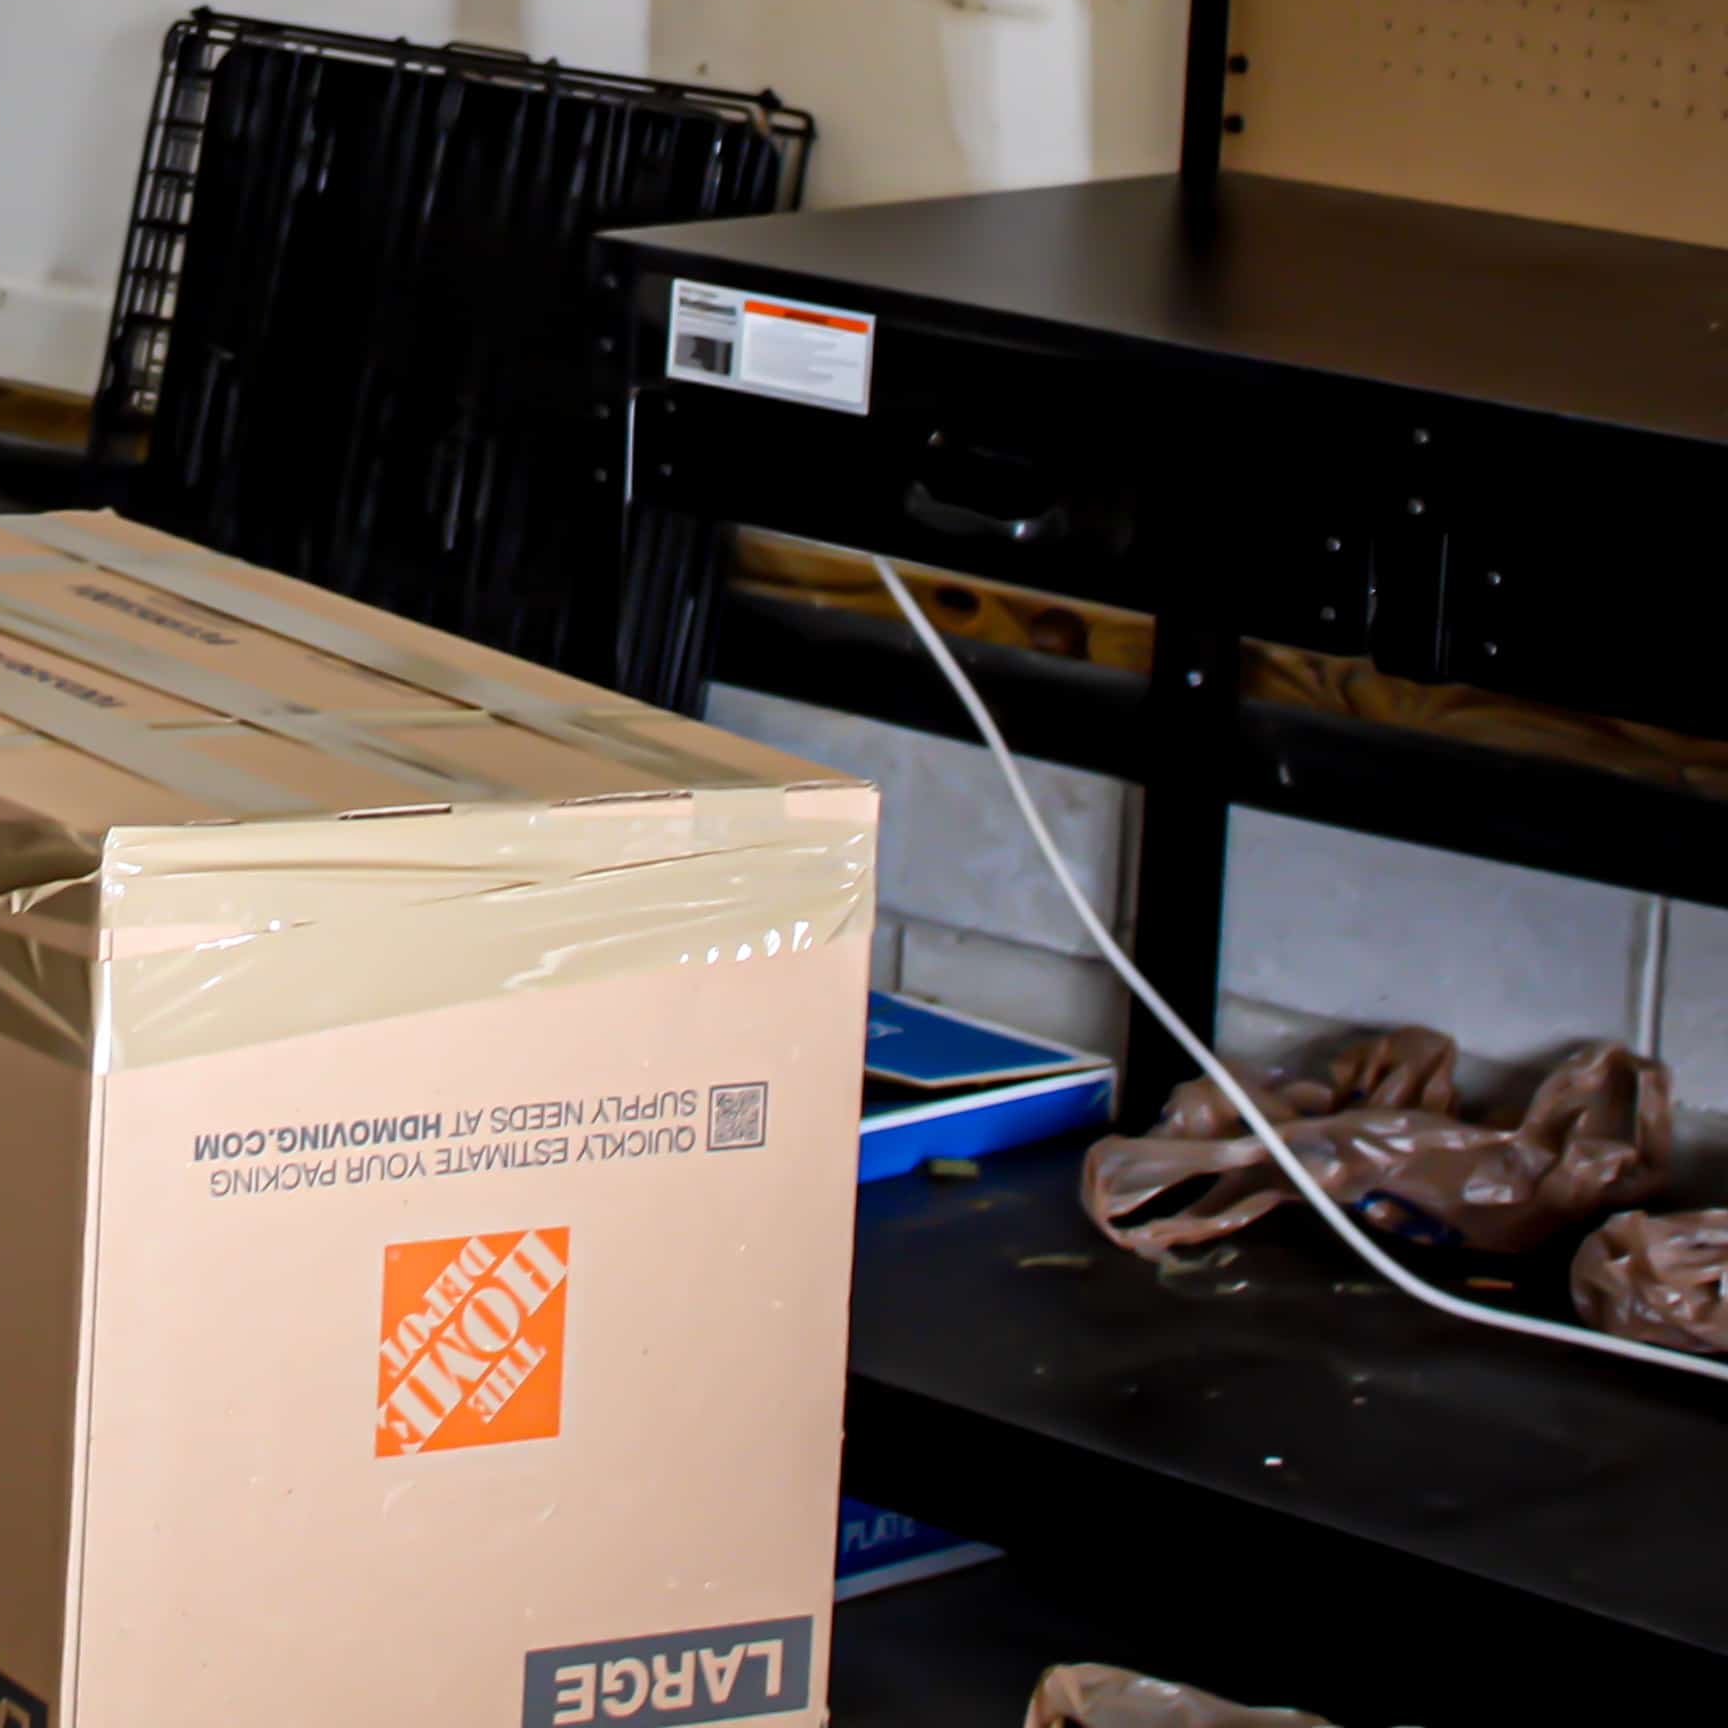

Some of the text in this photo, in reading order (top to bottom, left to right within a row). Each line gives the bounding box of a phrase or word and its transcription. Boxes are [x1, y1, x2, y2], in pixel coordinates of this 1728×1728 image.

[193, 1088, 698, 1162] SUPPLY NEEDS AT HDMOVING.COM
[209, 1124, 697, 1198] QUICKLY ESTIMATE YOUR PACKING
[375, 1229, 568, 1456] HOME
[378, 1235, 498, 1378] DEPOT
[466, 1335, 548, 1424] THE
[552, 1638, 784, 1726] LARGE
